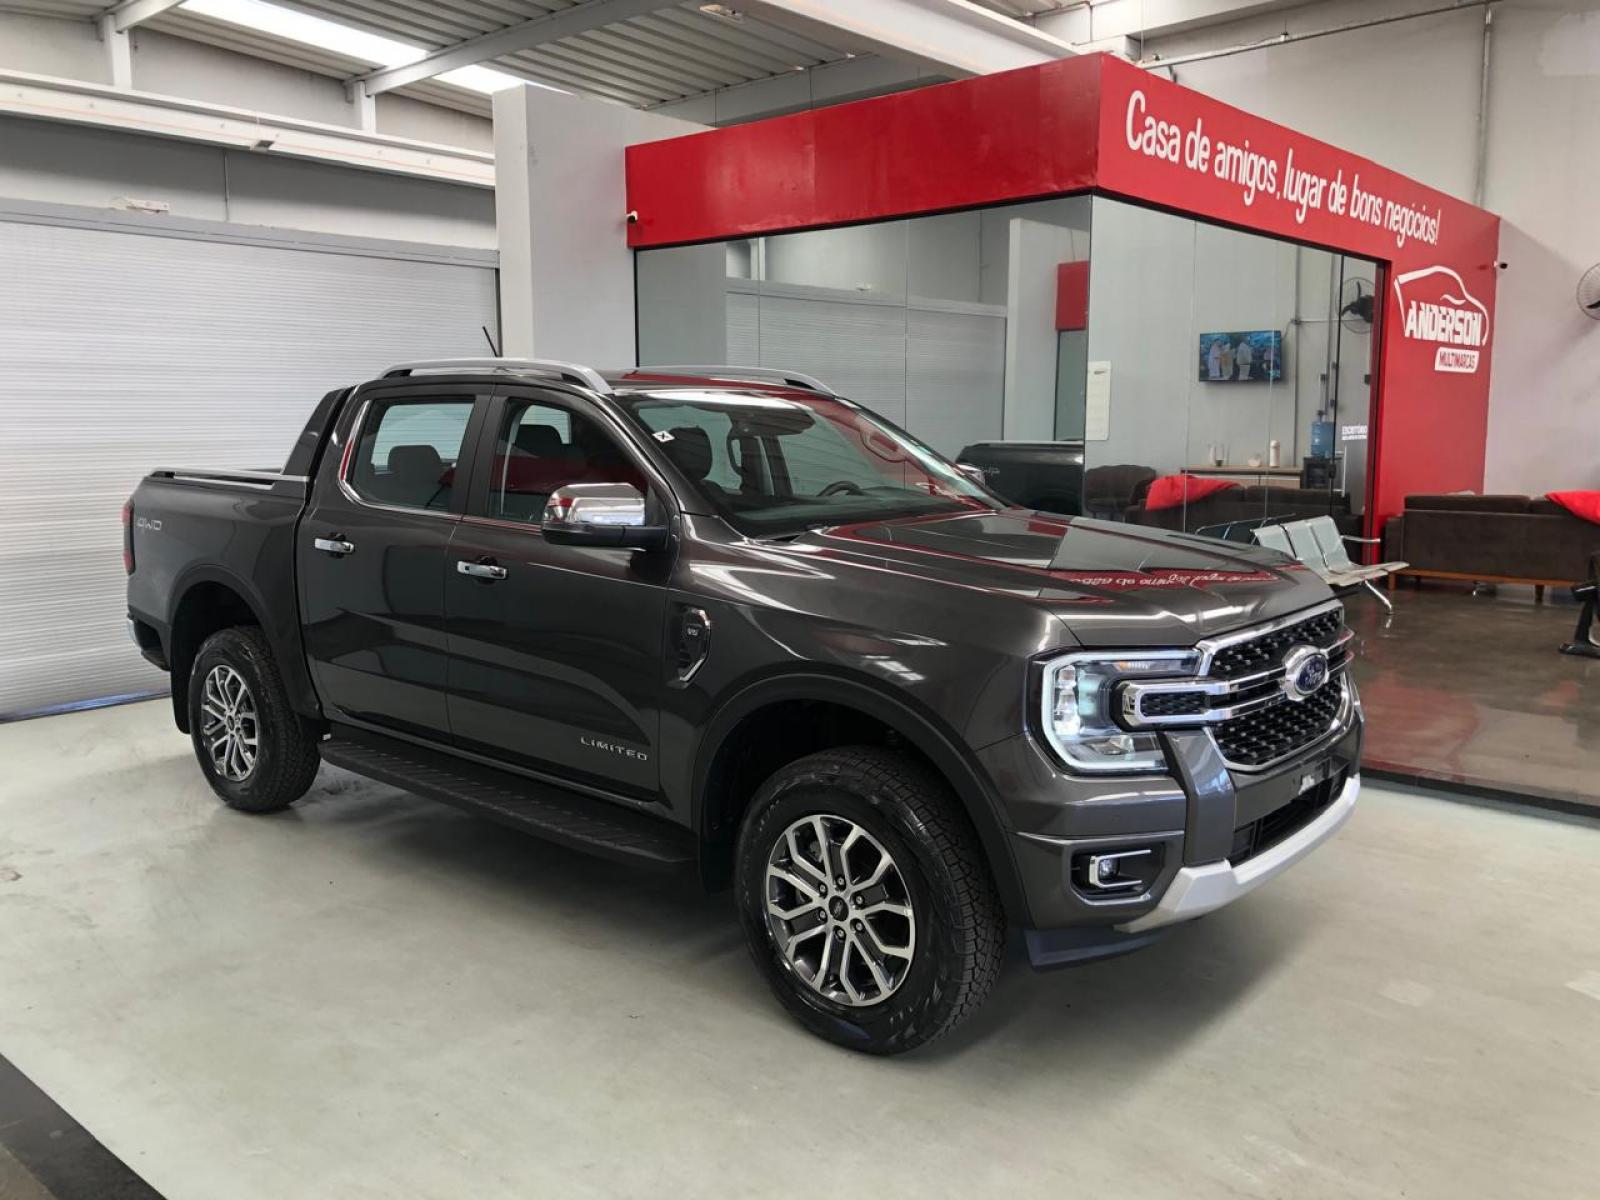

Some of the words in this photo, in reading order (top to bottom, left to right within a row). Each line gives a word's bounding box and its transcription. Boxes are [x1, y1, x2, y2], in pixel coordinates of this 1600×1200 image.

[1126, 90, 1181, 164] Casa
[1185, 117, 1210, 173] de
[1214, 140, 1281, 206] amigos,
[1283, 148, 1327, 224] lugar
[1328, 169, 1347, 215] de
[1350, 174, 1383, 225] bons
[1404, 300, 1482, 346] ANDERSON
[1440, 351, 1476, 369] MULTIMARCAS
[579, 735, 649, 762] LIMITED
